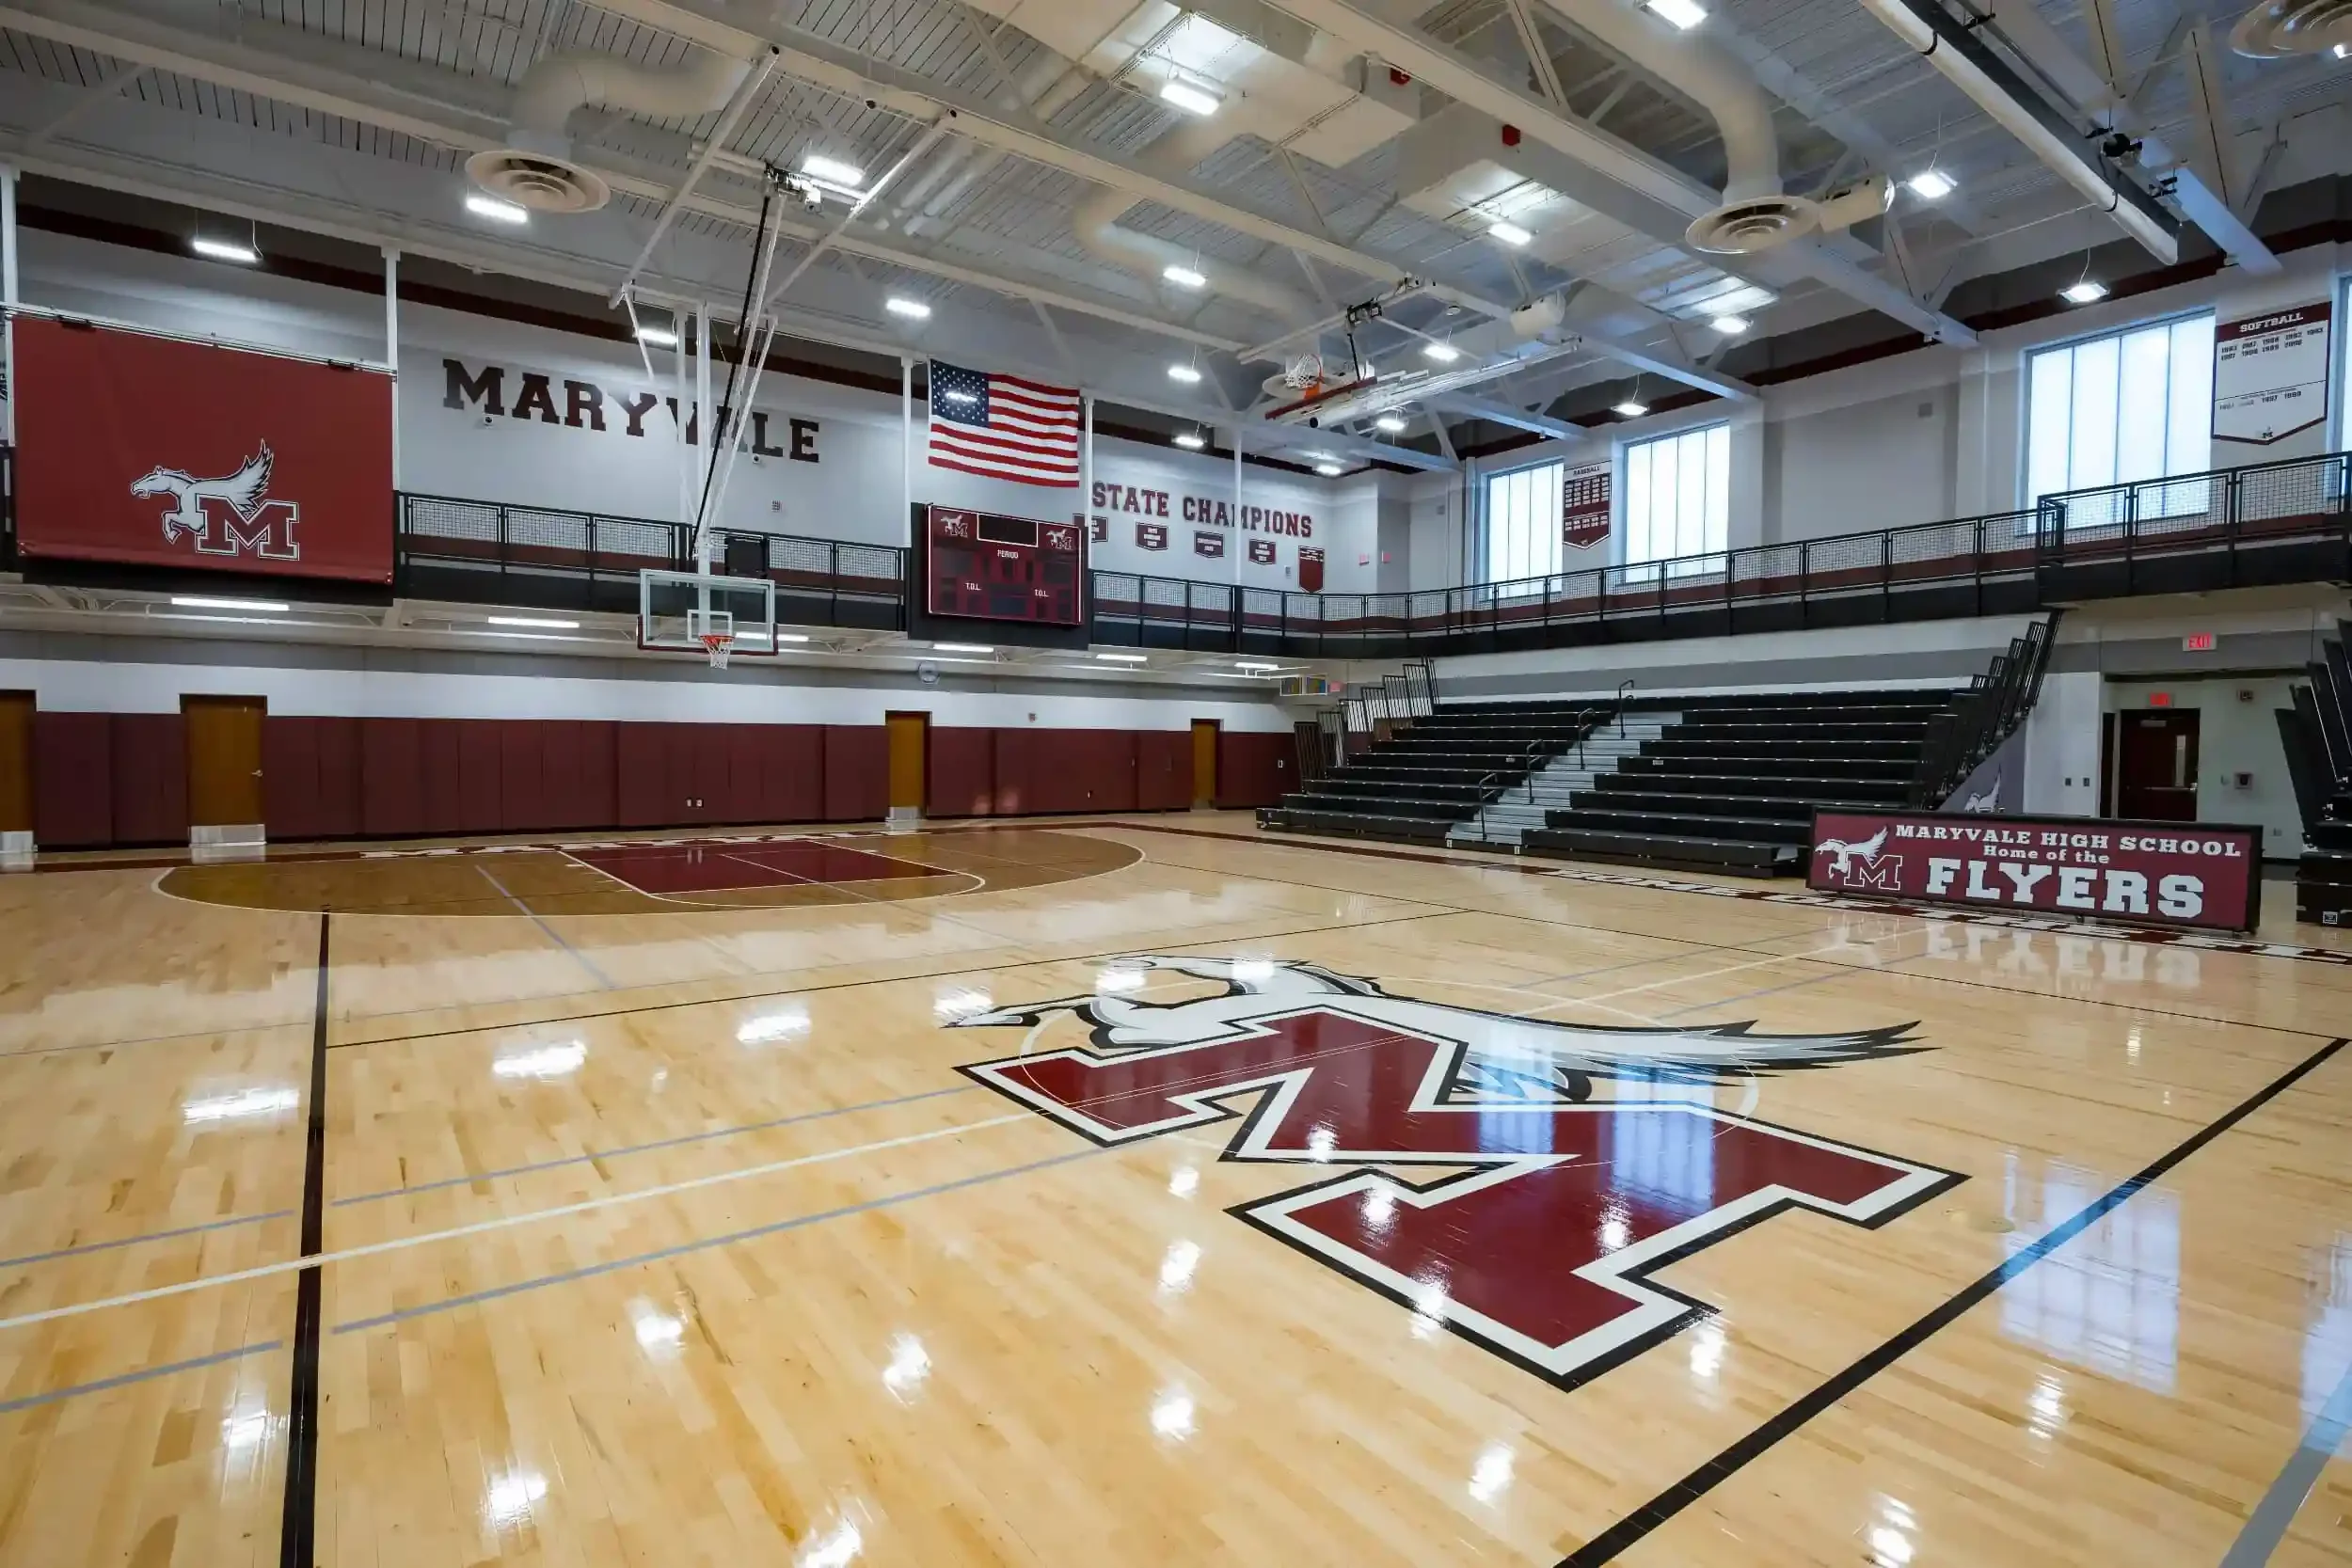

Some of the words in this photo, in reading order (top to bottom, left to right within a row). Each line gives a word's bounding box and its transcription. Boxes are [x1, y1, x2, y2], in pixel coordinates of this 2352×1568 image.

[2238, 312, 2304, 333] SOFTBALL
[195, 493, 299, 561] M
[1092, 482, 1169, 517] STATE
[1183, 496, 1312, 538] CHAMPIONS
[997, 548, 1019, 560] PERIOD
[1896, 824, 2031, 846] MARYVALE
[2042, 832, 2110, 849] HIGH
[2120, 837, 2242, 857] SCHOOL
[1984, 845, 2040, 861] Home
[2046, 849, 2068, 861] of
[2075, 851, 2110, 864] the
[1844, 850, 1903, 891] M
[1927, 857, 2204, 918] FLYERS
[954, 1003, 1972, 1393] M
